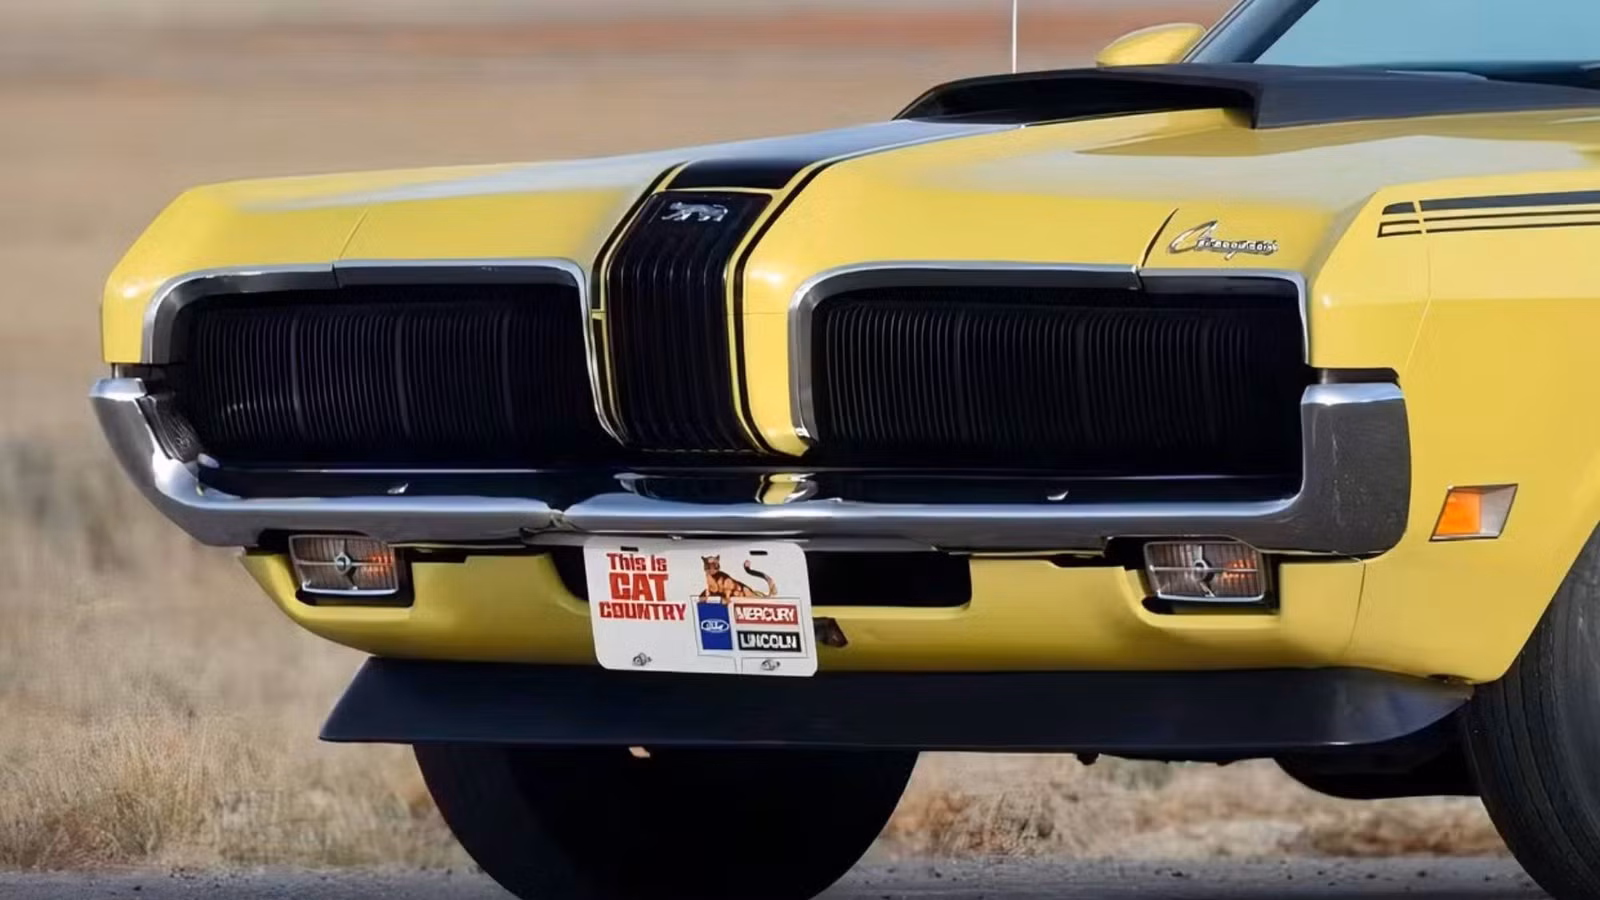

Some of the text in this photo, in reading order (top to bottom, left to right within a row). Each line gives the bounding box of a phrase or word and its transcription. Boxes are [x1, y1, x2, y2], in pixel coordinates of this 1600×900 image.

[606, 553, 647, 571] This
[609, 572, 669, 601] CAT
[599, 601, 687, 621] COUNTRY
[735, 606, 795, 622] MERCURY
[740, 633, 797, 649] LINCOLN
